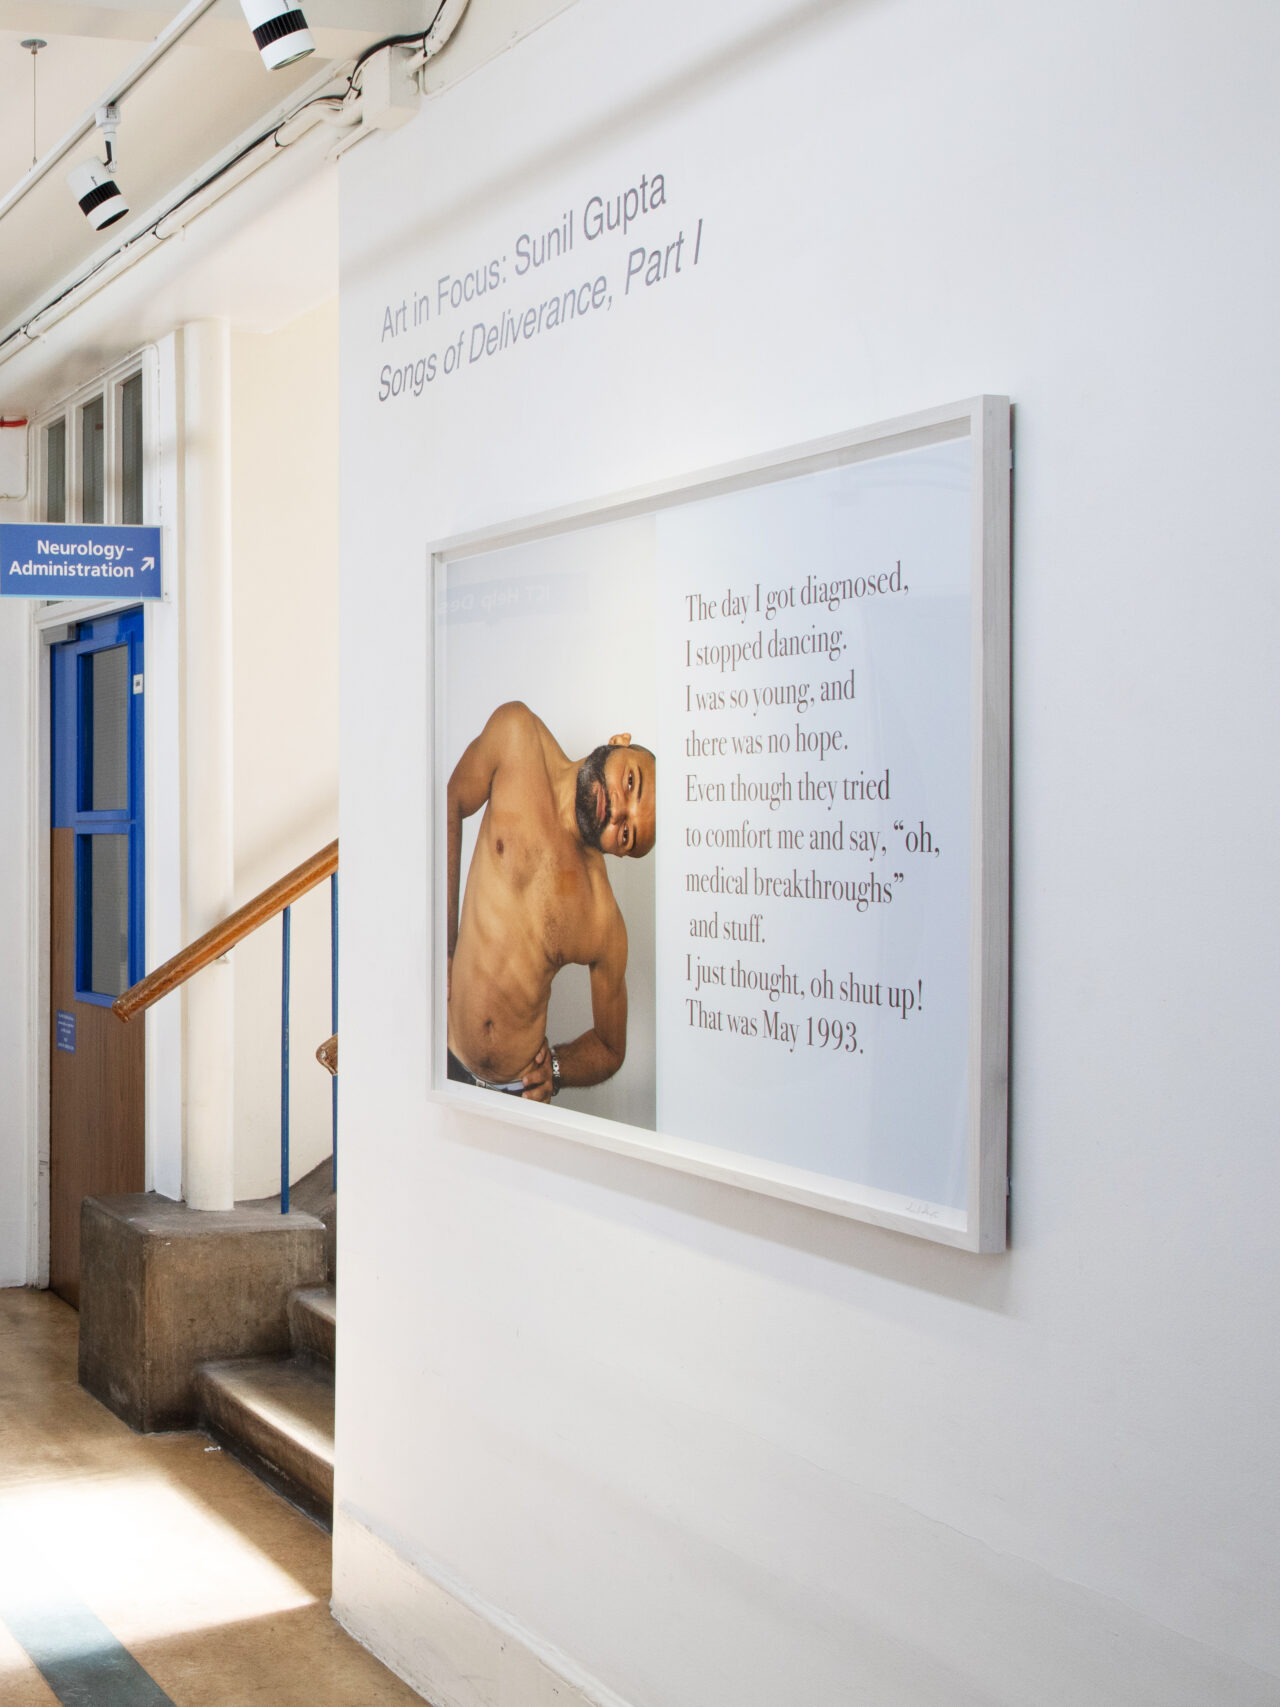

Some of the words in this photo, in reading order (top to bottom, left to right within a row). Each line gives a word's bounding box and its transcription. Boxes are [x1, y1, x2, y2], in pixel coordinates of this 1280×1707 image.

[382, 300, 407, 341] Art
[413, 292, 429, 326] in
[438, 256, 506, 315] Focus:
[515, 211, 573, 275] Sunil
[584, 173, 666, 240] Gupta
[379, 353, 436, 401] Songs
[444, 331, 465, 374] of
[469, 275, 612, 363] Deliverance,
[625, 232, 684, 294] Part
[694, 218, 703, 265] I
[9, 560, 133, 577] Administration
[686, 594, 716, 622] The
[722, 589, 750, 624] day
[756, 584, 760, 612] I
[765, 587, 796, 620] got
[801, 560, 909, 612] diagnosed,
[686, 640, 691, 667] I
[696, 631, 763, 672] stopped
[768, 625, 847, 661] dancing.
[686, 685, 691, 711] I
[696, 687, 725, 711] was
[730, 687, 748, 708] so
[753, 683, 815, 716] young,
[820, 669, 855, 701] and
[686, 730, 727, 756] there
[733, 734, 762, 754] was
[768, 732, 790, 752] no
[796, 723, 848, 761] hope.
[686, 775, 725, 801] Even
[731, 772, 791, 810] though
[797, 772, 836, 810] they
[843, 769, 890, 800] tried
[686, 827, 701, 847] to
[706, 820, 772, 849] comfort
[778, 829, 804, 849] me
[810, 821, 843, 850] and
[849, 831, 887, 861] say,
[686, 866, 748, 895] medical
[754, 869, 904, 912] breakthroughs”
[690, 912, 718, 939] and
[723, 914, 765, 943] stuff.
[686, 954, 692, 981] I
[695, 956, 726, 991] just
[730, 960, 805, 1001] thought,
[811, 969, 834, 1000] oh
[839, 972, 884, 1006] shut
[888, 979, 922, 1019] up!
[686, 999, 722, 1031] That
[727, 1012, 757, 1036] was
[763, 1010, 799, 1052] May
[807, 1017, 863, 1054] 1993.
